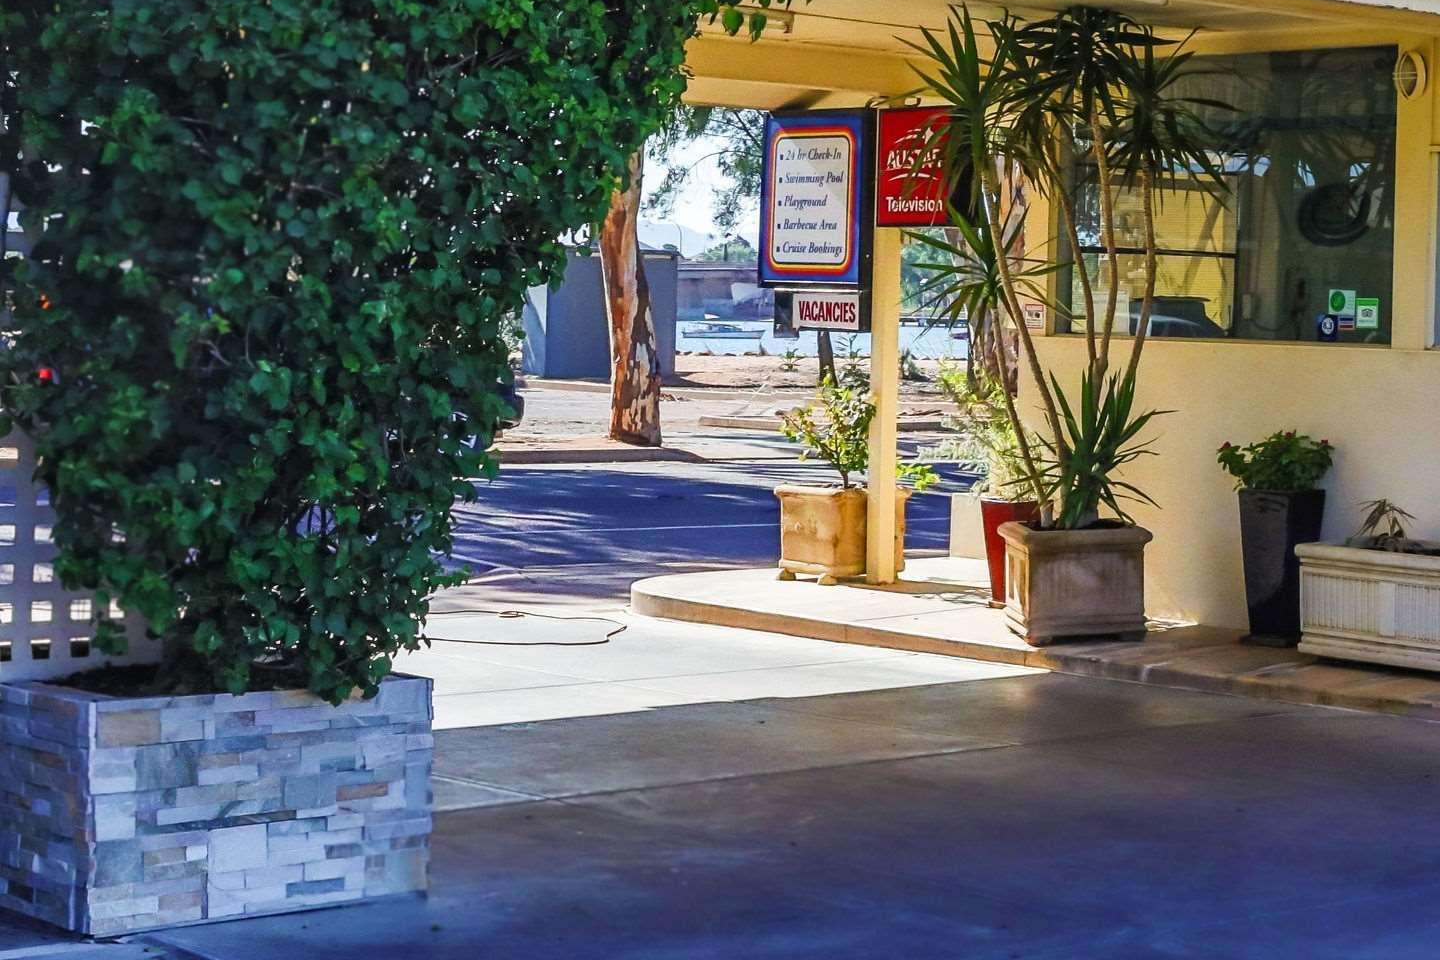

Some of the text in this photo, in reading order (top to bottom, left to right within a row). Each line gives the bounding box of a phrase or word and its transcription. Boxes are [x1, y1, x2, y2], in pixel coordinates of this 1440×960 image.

[808, 147, 842, 160] Check-In
[785, 171, 844, 187] Swimming Pool
[784, 194, 828, 210] Playground
[886, 196, 944, 212] Television
[783, 218, 837, 230] Barbecue Area
[782, 241, 843, 257] Cruise Bookings
[798, 300, 857, 323] VACANCIES
